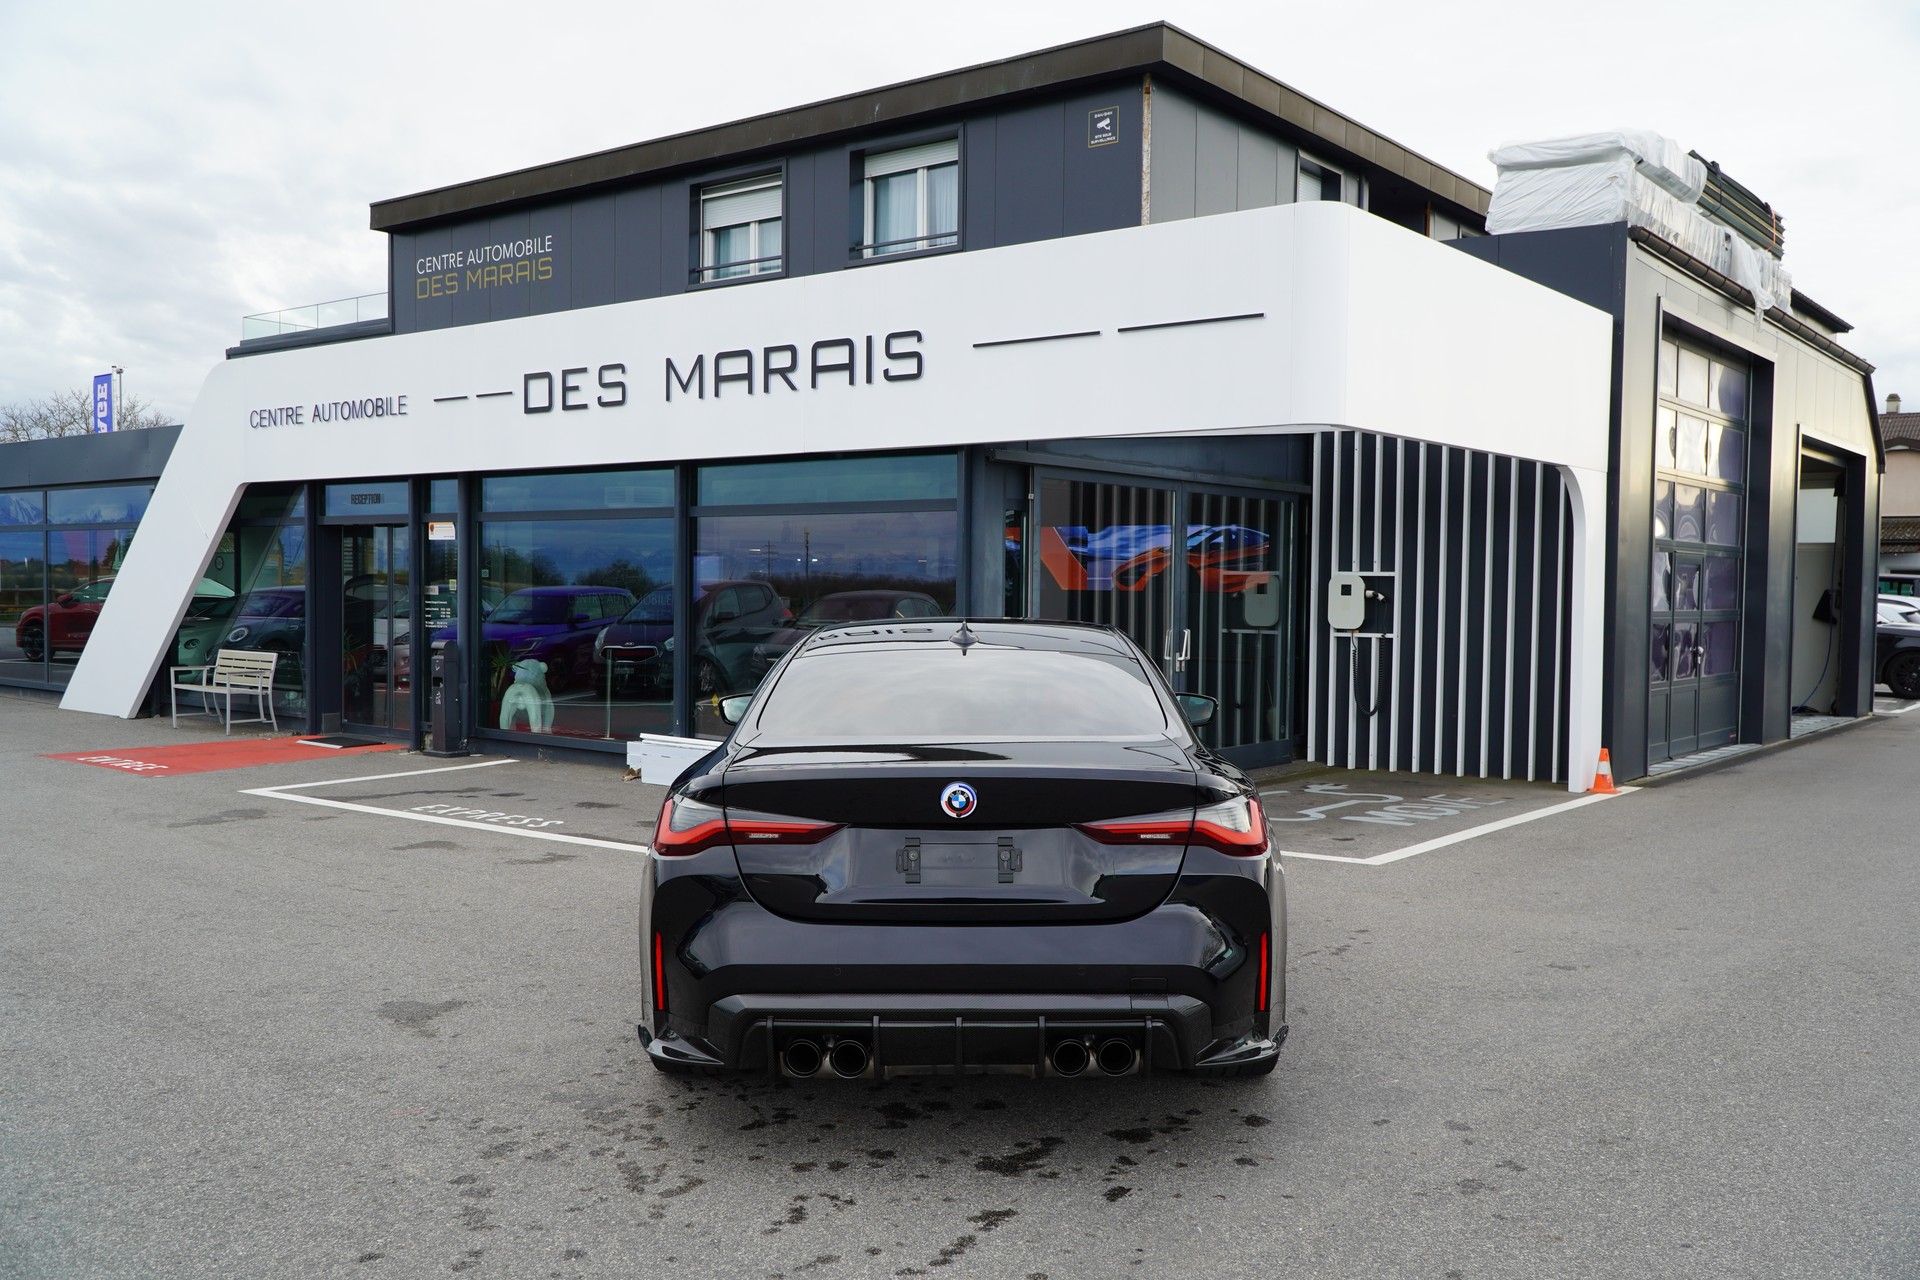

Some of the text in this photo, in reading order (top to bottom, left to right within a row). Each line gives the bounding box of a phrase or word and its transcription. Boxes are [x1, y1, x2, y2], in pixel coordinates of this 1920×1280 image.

[416, 235, 553, 275] CENTRE AUTOMOBILE
[416, 257, 553, 299] DES MARAIS
[249, 329, 923, 429] CENTRE AUTOMOBILE DES MARAIS
[409, 803, 565, 828] EXPRESS
